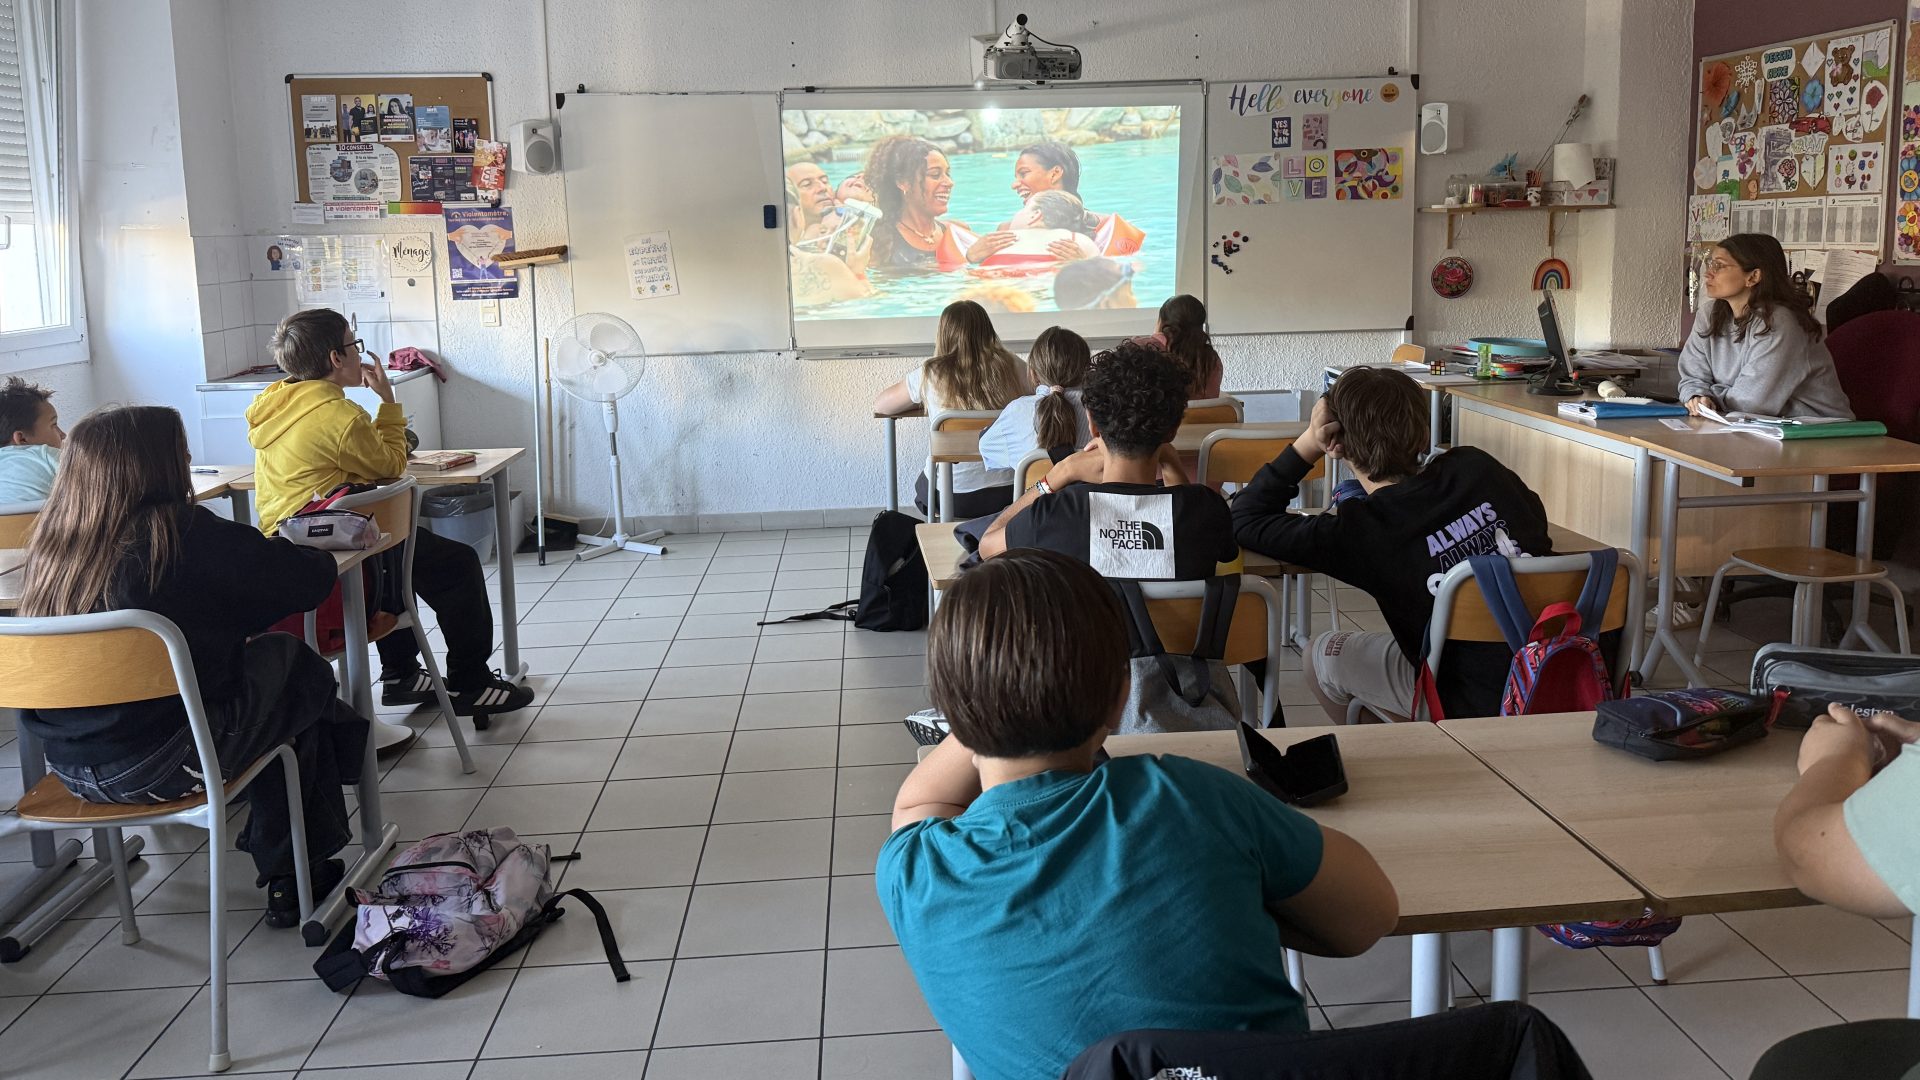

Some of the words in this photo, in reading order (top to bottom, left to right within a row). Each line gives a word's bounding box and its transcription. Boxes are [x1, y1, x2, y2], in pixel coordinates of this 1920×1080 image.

[1764, 49, 1793, 64] DESSIN
[1228, 83, 1286, 116] Hello
[1294, 88, 1374, 111] everyone
[1275, 120, 1288, 128] YES
[1273, 137, 1288, 145] CAN
[392, 241, 430, 263] Ménage
[1117, 520, 1141, 530] THE
[1426, 502, 1498, 558] ALWAYS
[1100, 529, 1142, 539] NORTH
[1112, 539, 1142, 550] FACE
[1166, 1066, 1202, 1078] FACE
